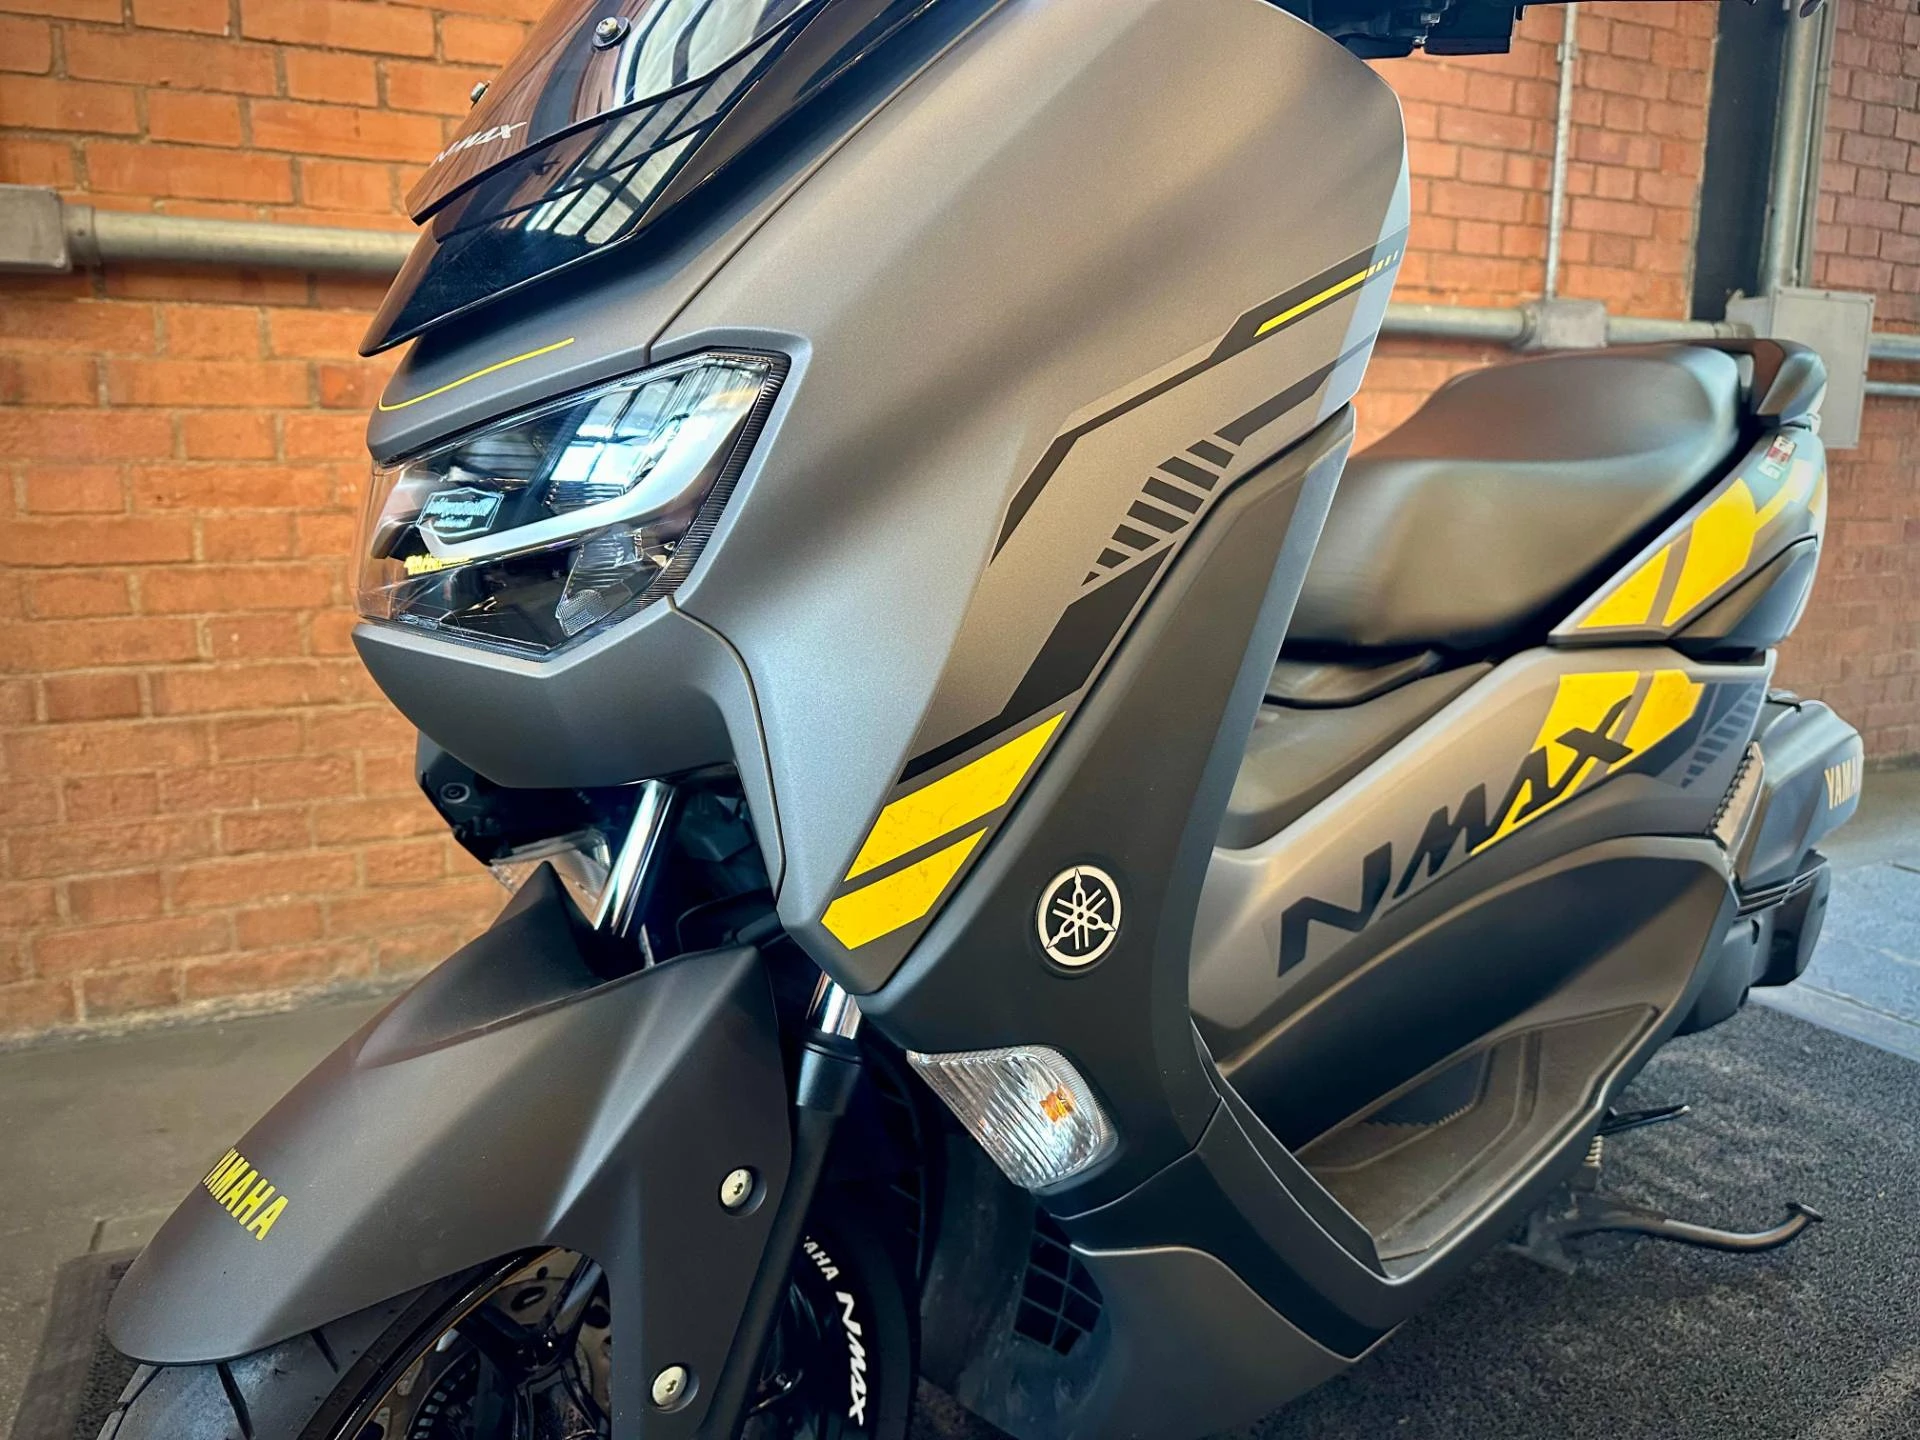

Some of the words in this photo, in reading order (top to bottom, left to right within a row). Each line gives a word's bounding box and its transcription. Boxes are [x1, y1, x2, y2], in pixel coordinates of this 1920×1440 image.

[1277, 693, 1634, 978] NMAX
[202, 1146, 289, 1241] YAMAHA
[803, 1235, 840, 1281] AHA
[835, 1290, 867, 1427] NMAX
